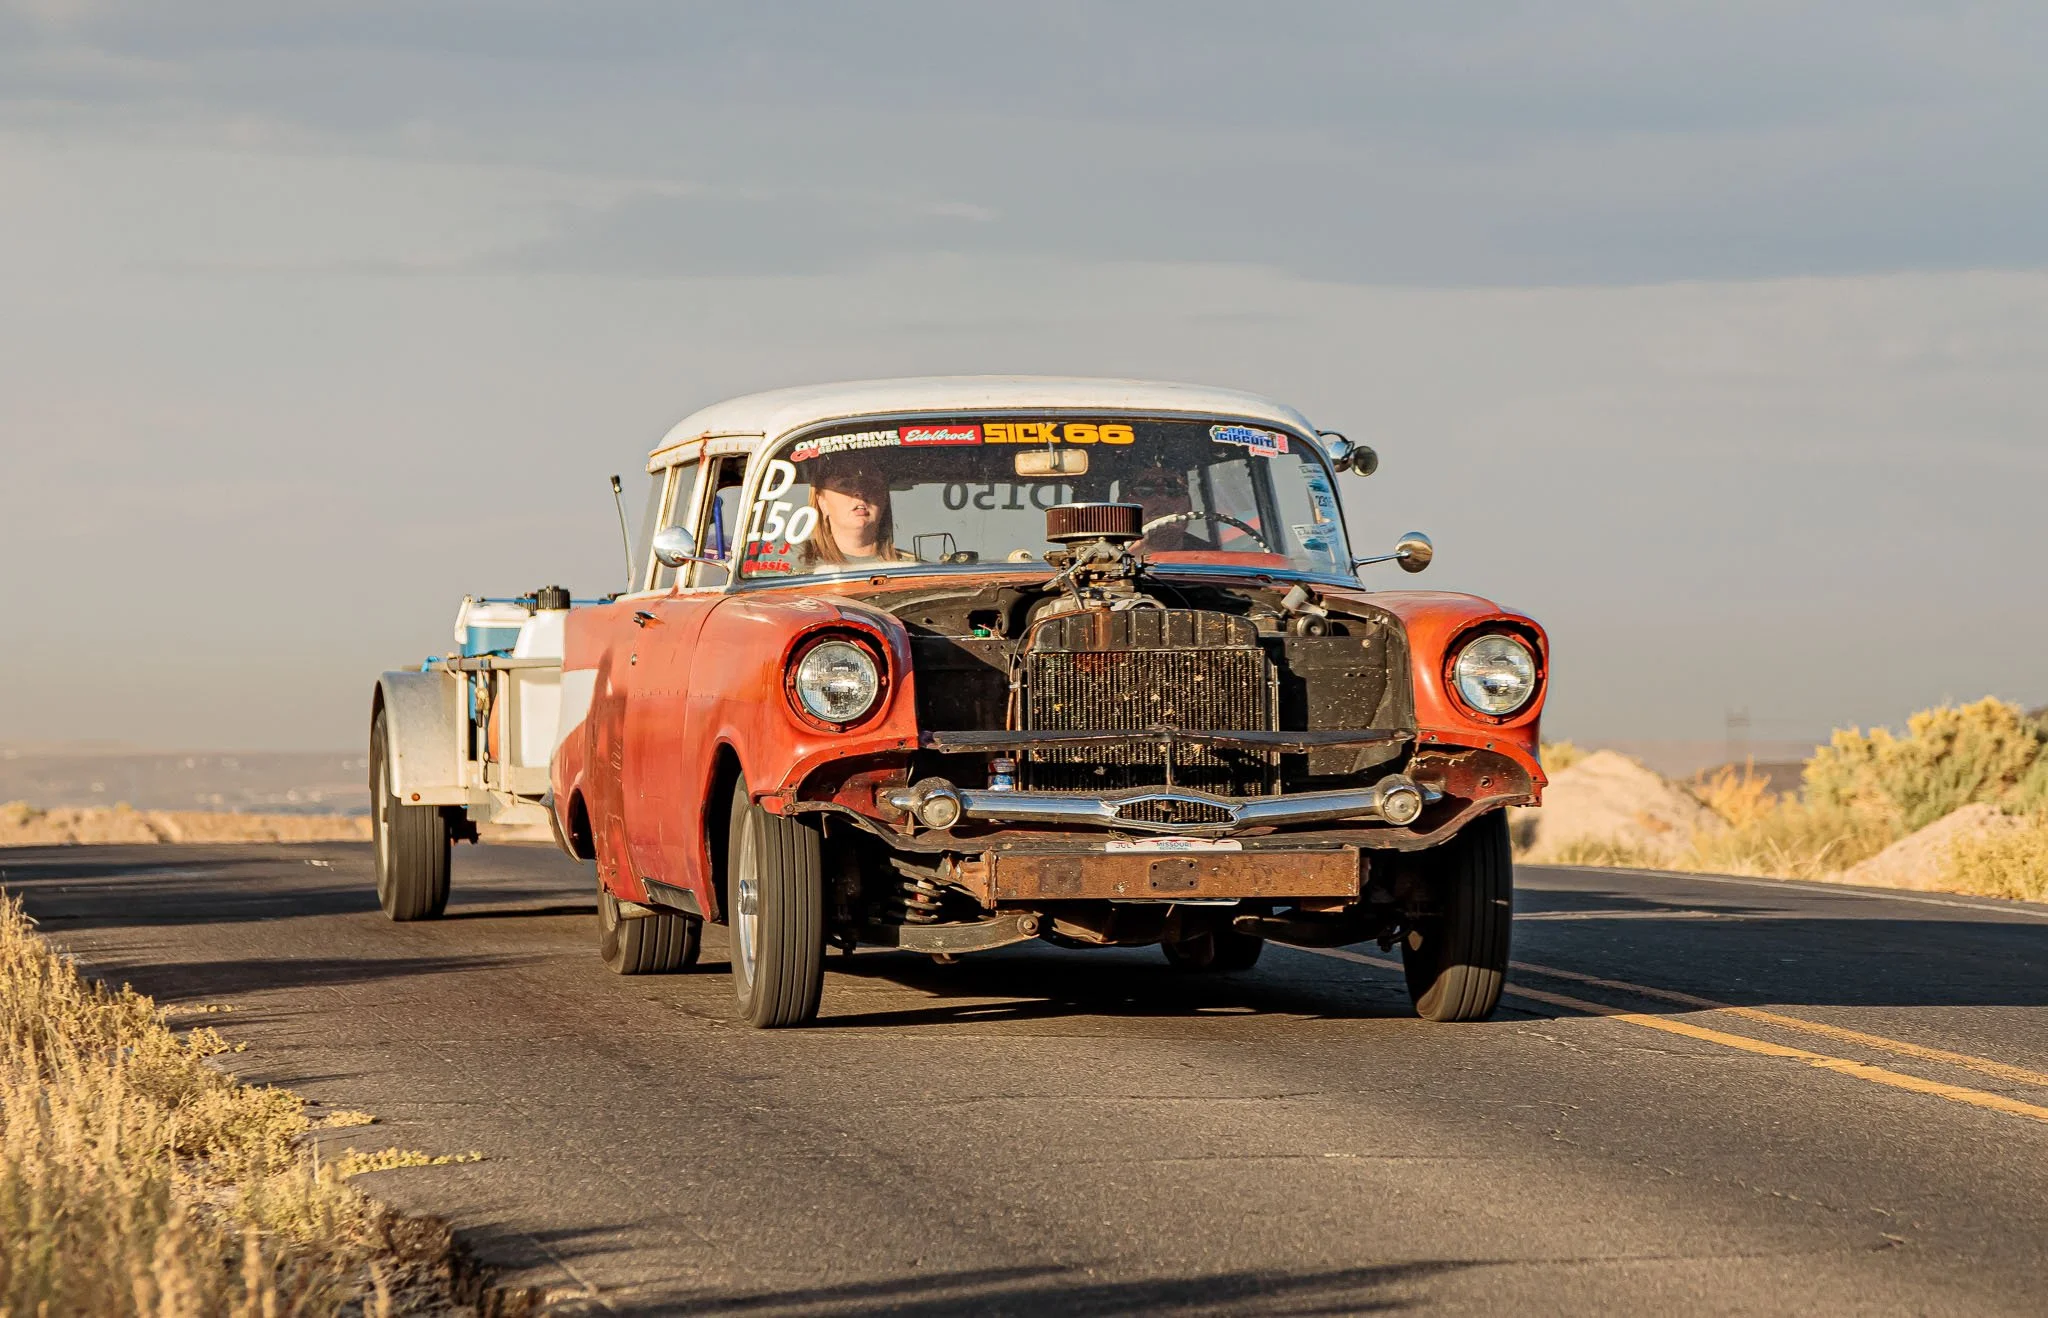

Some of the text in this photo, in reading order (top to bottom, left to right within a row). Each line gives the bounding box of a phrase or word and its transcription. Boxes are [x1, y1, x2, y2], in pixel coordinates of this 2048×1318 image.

[794, 430, 899, 451] OVERDRIVE
[904, 429, 976, 443] Edelbrock
[983, 423, 1135, 445] SICK 66
[1219, 432, 1274, 448] CIRCUIT
[1229, 428, 1252, 436] THE
[818, 438, 901, 454] GEAR VENDORS
[758, 459, 797, 501] D
[747, 500, 819, 545] 150
